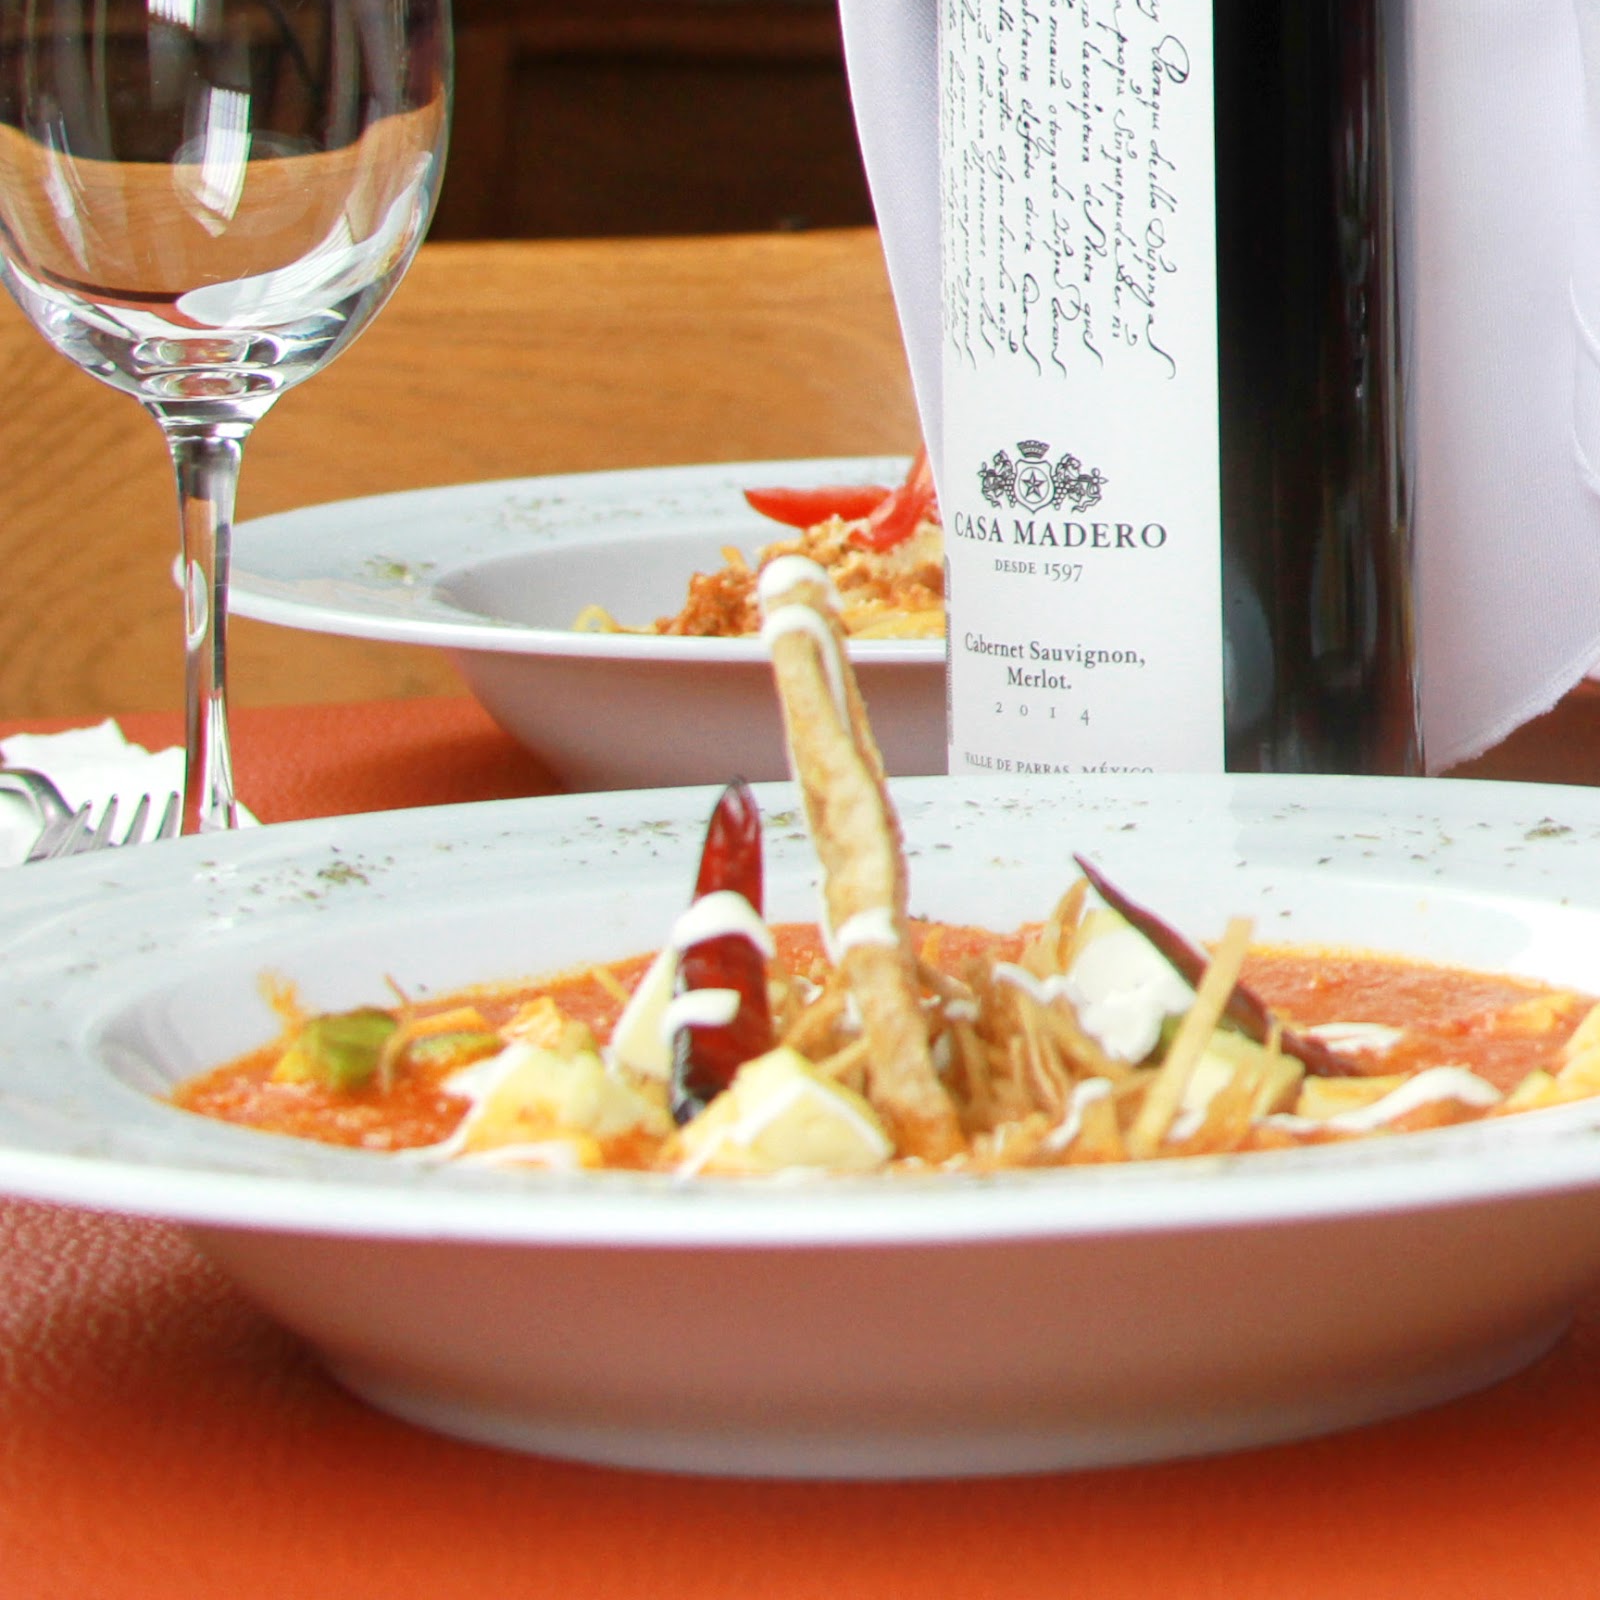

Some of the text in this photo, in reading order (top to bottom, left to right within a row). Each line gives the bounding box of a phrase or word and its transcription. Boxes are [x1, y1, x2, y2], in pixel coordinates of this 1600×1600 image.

[955, 512, 1168, 549] CASA MADERO
[994, 558, 1083, 583] DESDE 1597
[964, 632, 1146, 669] Cabernet Sauvignon,
[1006, 666, 1073, 690] Merlot.
[964, 752, 993, 769] VALLE
[996, 758, 1012, 772] DE
[1016, 761, 1070, 774] PARRAS
